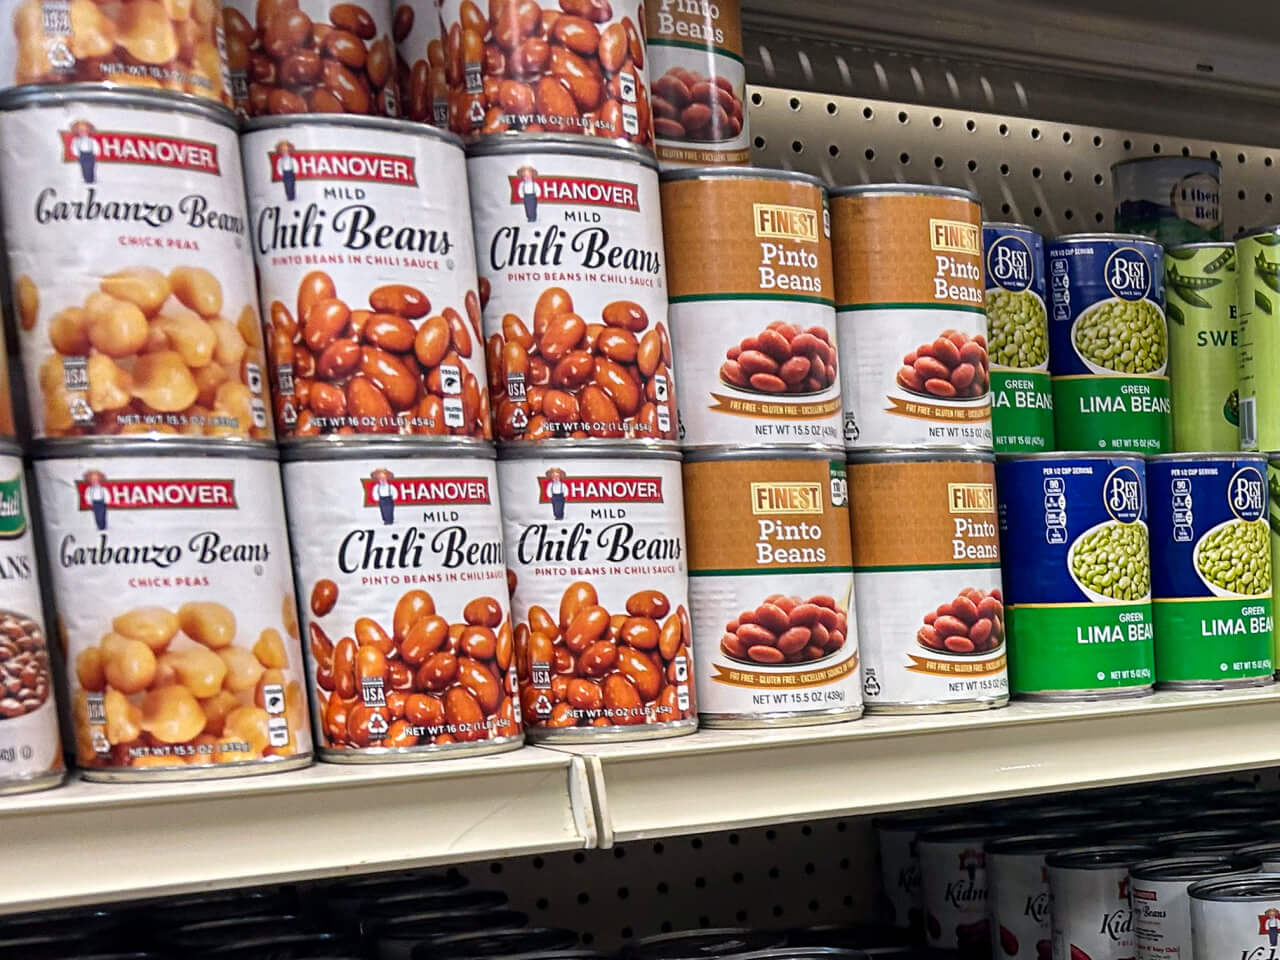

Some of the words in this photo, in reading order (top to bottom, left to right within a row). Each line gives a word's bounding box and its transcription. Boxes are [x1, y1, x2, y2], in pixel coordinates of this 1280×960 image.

[658, 16, 724, 43] Beans
[101, 139, 213, 168] HANOVER
[301, 156, 409, 180] HANOVER
[325, 187, 366, 199] MILD
[543, 181, 633, 204] HANOVER
[258, 204, 327, 254] Chili
[332, 206, 454, 256] Beans
[935, 224, 979, 249] FINEST
[761, 243, 818, 269] Pinto
[936, 256, 980, 281] Pinto
[508, 273, 540, 282] PINTO
[544, 273, 582, 282] BEANS
[585, 274, 596, 283] IN
[600, 274, 627, 285] CHILI
[629, 277, 653, 287] SAUCE
[934, 278, 981, 302] Beans
[1005, 380, 1034, 389] GREEN
[1080, 397, 1126, 413] LIMA
[1130, 397, 1170, 414] BEANS
[112, 484, 228, 505] HANOVER
[400, 482, 486, 500] HANOVER
[571, 481, 656, 499] HANOVER
[759, 519, 821, 540] Pinto
[954, 518, 995, 538] Pinto
[60, 532, 181, 568] Garbanzo
[189, 532, 271, 564] Beans
[756, 544, 825, 563] Beans
[952, 541, 998, 560] Beans
[362, 575, 399, 585] PINTO
[403, 574, 442, 585] BEANS
[445, 573, 457, 582] IN
[460, 570, 484, 581] CHILI
[535, 567, 567, 576] PINTO
[570, 566, 607, 576] BEANS
[609, 566, 620, 575] IN
[623, 566, 650, 575] CHILI
[653, 565, 675, 574] SAUCE
[533, 671, 550, 684] USA
[362, 686, 385, 702] USA
[753, 695, 774, 705] NET
[777, 695, 792, 704] WT
[793, 694, 811, 703] 15.5
[814, 692, 824, 702] OZ
